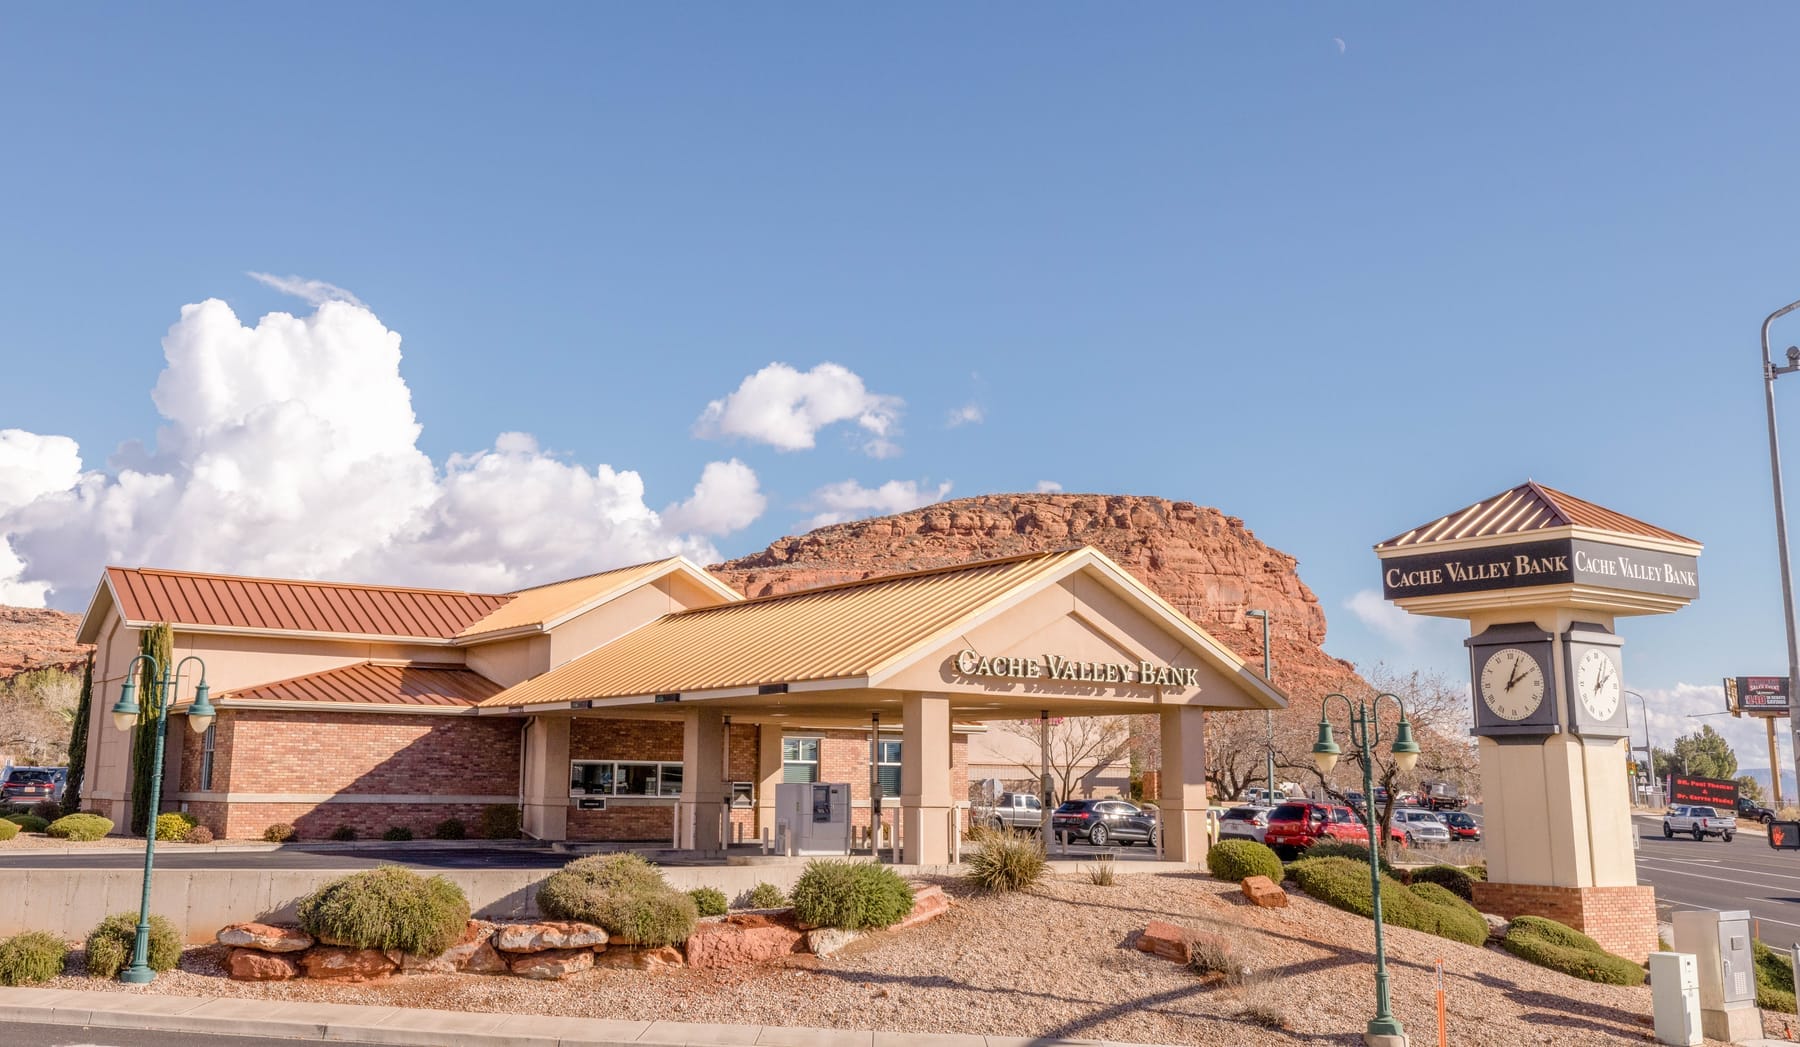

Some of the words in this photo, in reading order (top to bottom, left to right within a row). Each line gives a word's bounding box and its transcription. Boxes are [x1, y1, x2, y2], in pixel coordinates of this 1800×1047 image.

[1385, 568, 1443, 588] CACHE
[1445, 561, 1511, 582] VALLEY
[1514, 555, 1569, 576] BANK
[1574, 550, 1617, 576] CACHE
[1618, 557, 1662, 582] VALLEY
[1663, 563, 1696, 586] BANK
[957, 649, 1041, 679] CACHE
[1044, 654, 1132, 683] VALLEY
[1139, 660, 1200, 687] BANK
